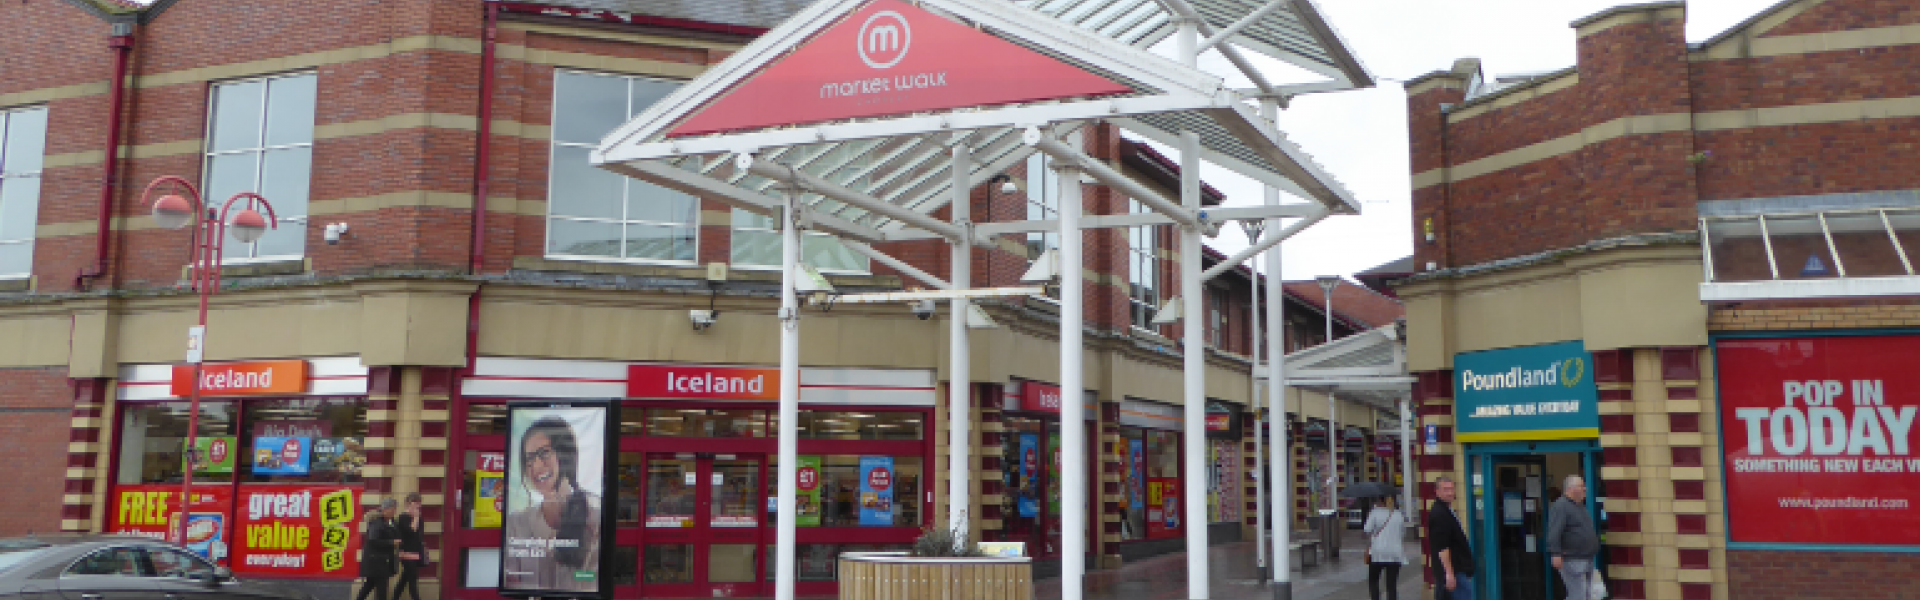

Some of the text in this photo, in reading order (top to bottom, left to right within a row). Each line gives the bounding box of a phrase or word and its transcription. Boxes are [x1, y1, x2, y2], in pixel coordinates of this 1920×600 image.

[820, 71, 948, 98] market walk
[199, 367, 272, 390] Iceland
[667, 371, 763, 393] Iceland
[1461, 360, 1557, 392] Poundland
[1783, 380, 1885, 406] POP IN
[1735, 405, 1918, 456] TODAY
[1733, 458, 1821, 473] SOMETHING
[1824, 458, 1859, 473] NEW
[1862, 458, 1904, 473] EACH
[119, 491, 168, 525] FREE
[248, 491, 311, 520] great
[325, 495, 348, 520] £1
[1778, 497, 1910, 510] www.poundland.com
[246, 521, 309, 550] value
[324, 528, 345, 545] £2
[246, 553, 305, 567] everyday!
[326, 552, 341, 568] £3
